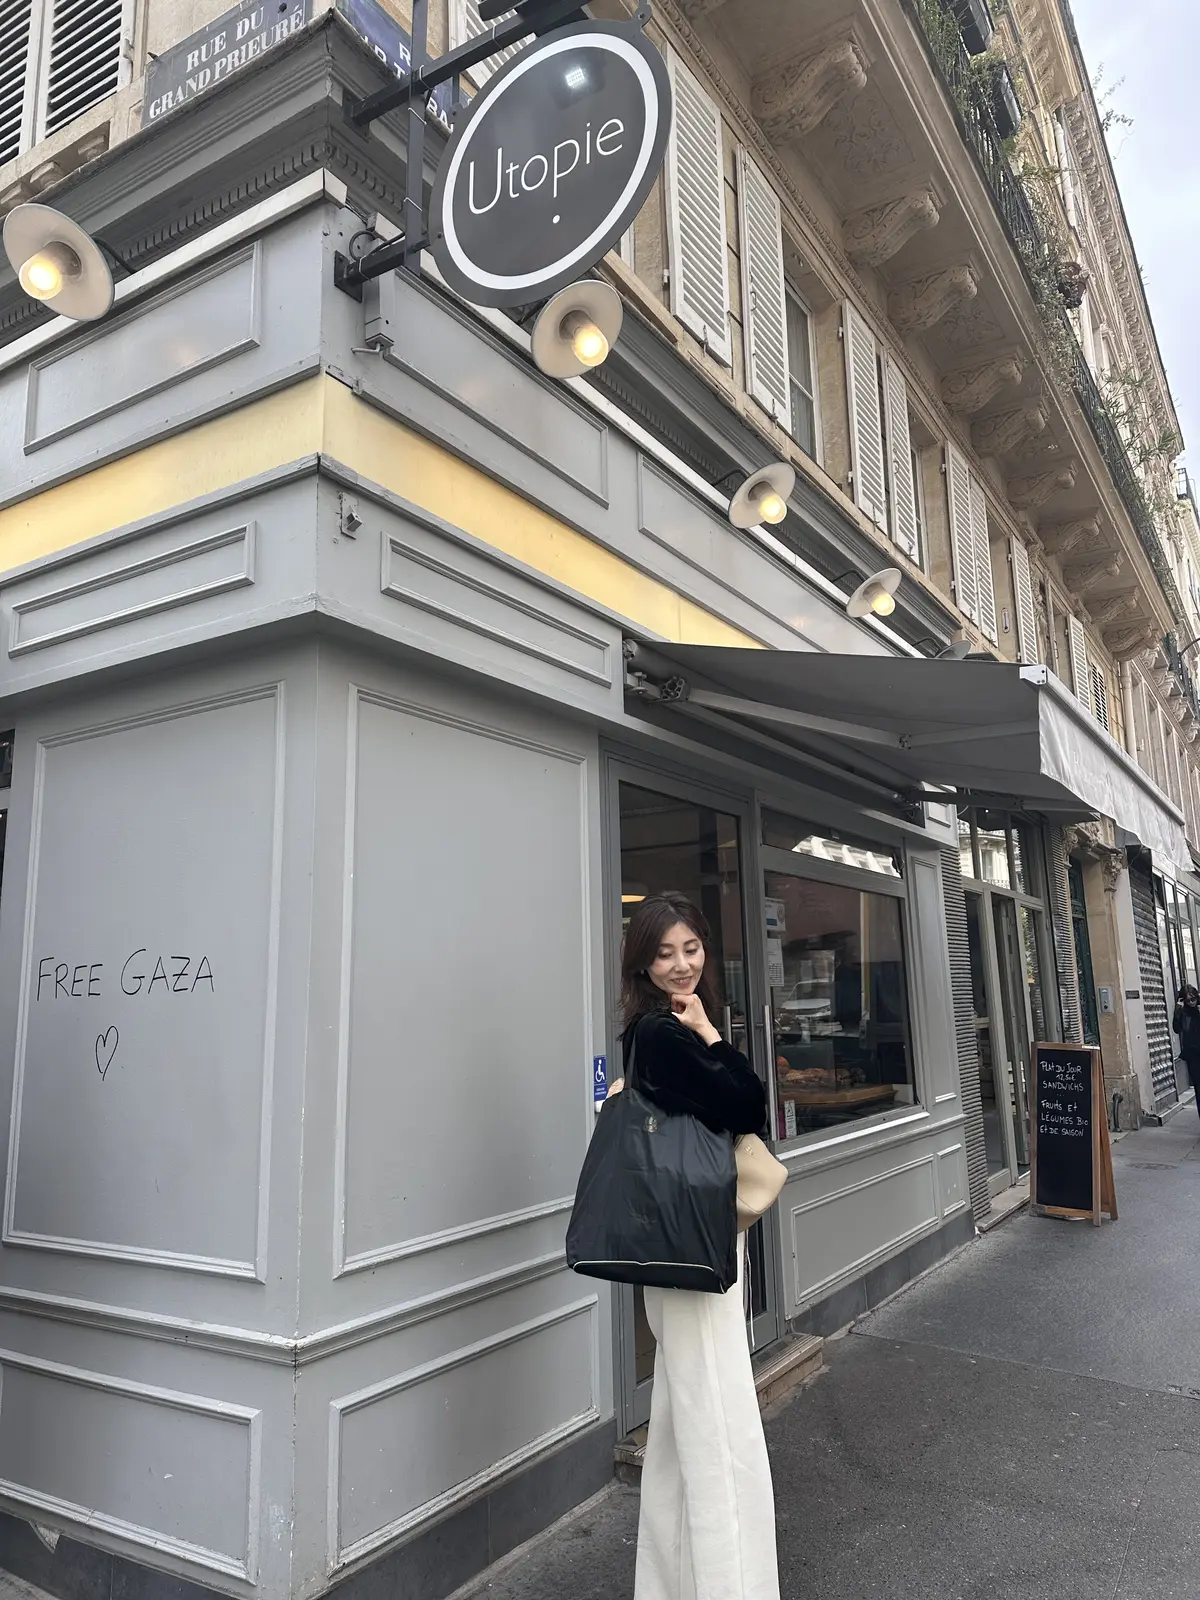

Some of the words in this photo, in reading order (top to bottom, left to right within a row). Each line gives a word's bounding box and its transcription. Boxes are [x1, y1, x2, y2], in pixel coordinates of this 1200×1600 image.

[186, 31, 227, 73] RUE
[236, 7, 265, 42] DU
[149, 67, 211, 119] GRAND
[213, 4, 303, 81] PRIEURÉ
[469, 118, 625, 215] Utopie
[36, 956, 103, 1001] FREE
[121, 948, 215, 996] GAZA
[1055, 1064, 1065, 1073] DU
[1042, 1080, 1084, 1092] SANDWICHS
[1041, 1111, 1074, 1125] LÉGUMES
[1049, 1127, 1059, 1135] DE
[1061, 1127, 1084, 1137] SAISON
